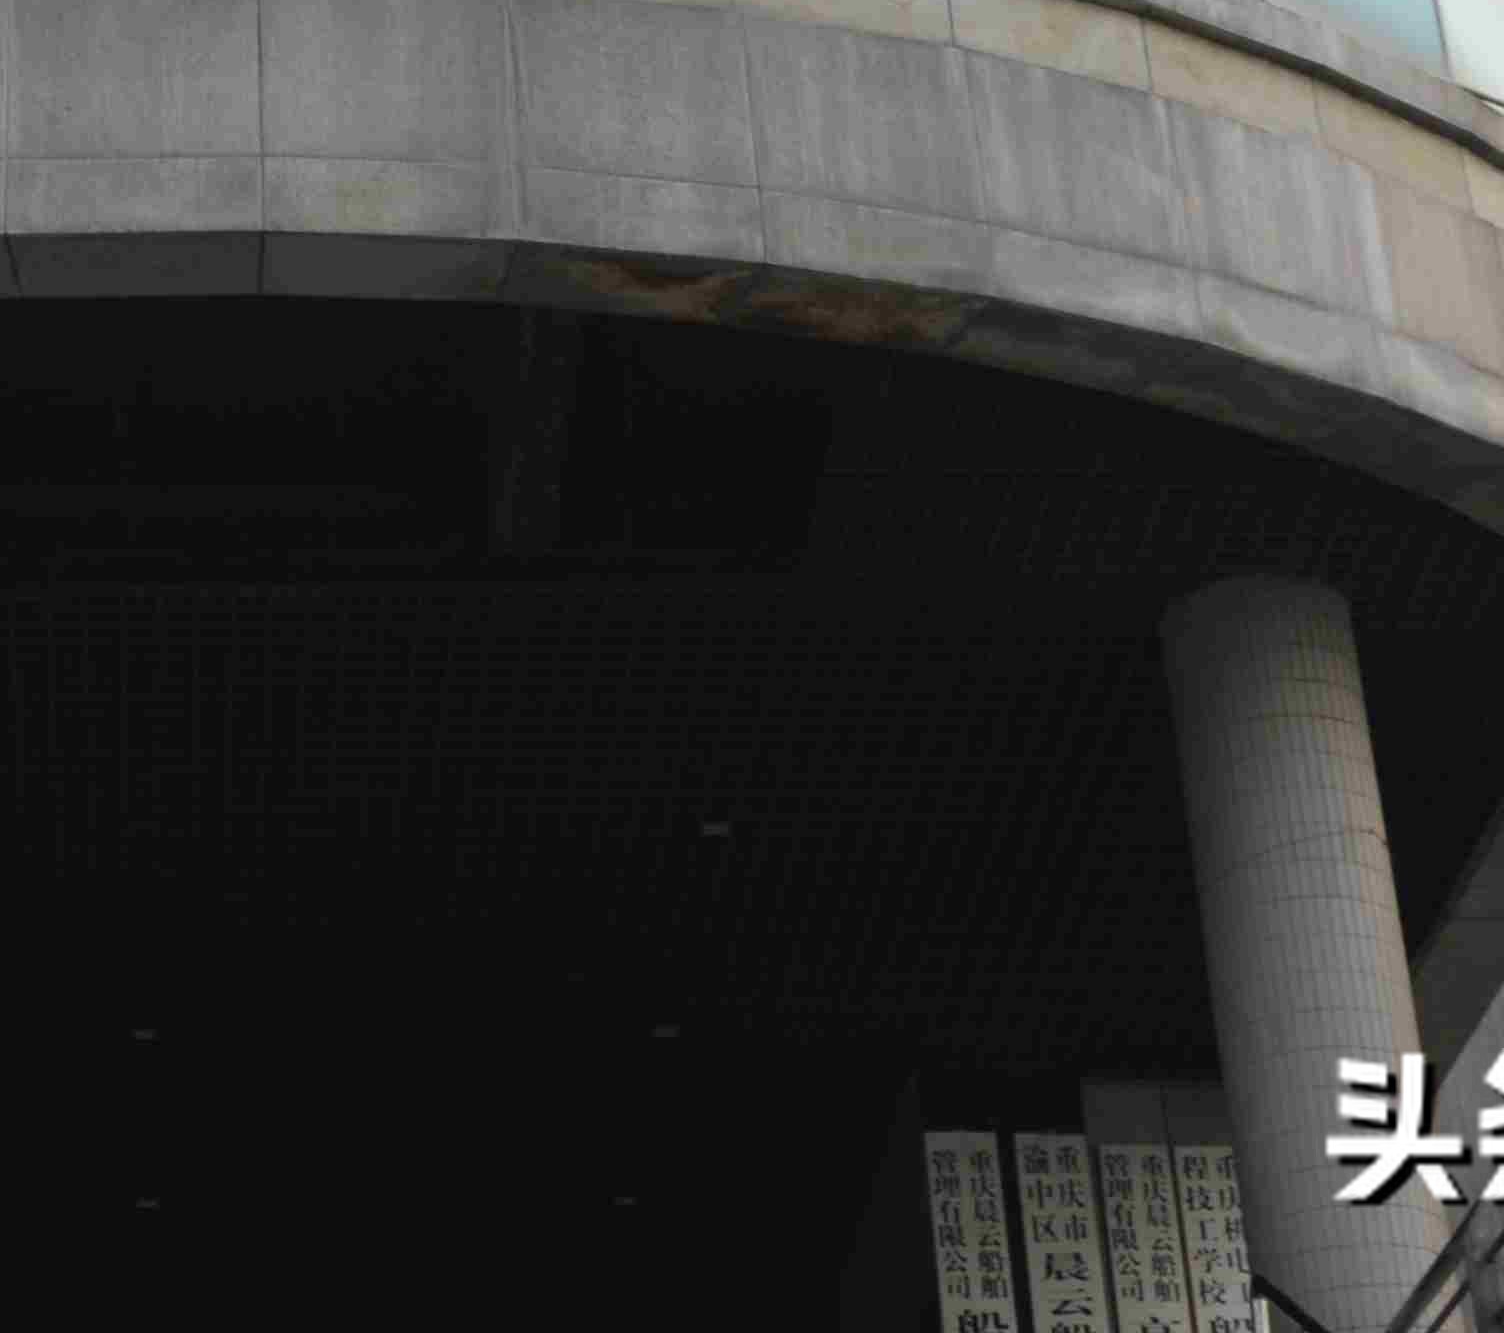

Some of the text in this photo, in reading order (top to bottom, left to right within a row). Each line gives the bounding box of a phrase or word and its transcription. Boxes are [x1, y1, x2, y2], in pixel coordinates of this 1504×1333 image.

[931, 1148, 970, 1300] 管理有限公司
[1023, 1144, 1061, 1245] 渝中区
[1056, 1144, 1089, 1244] 重庆市
[1103, 1155, 1144, 1301] 管理有限公司
